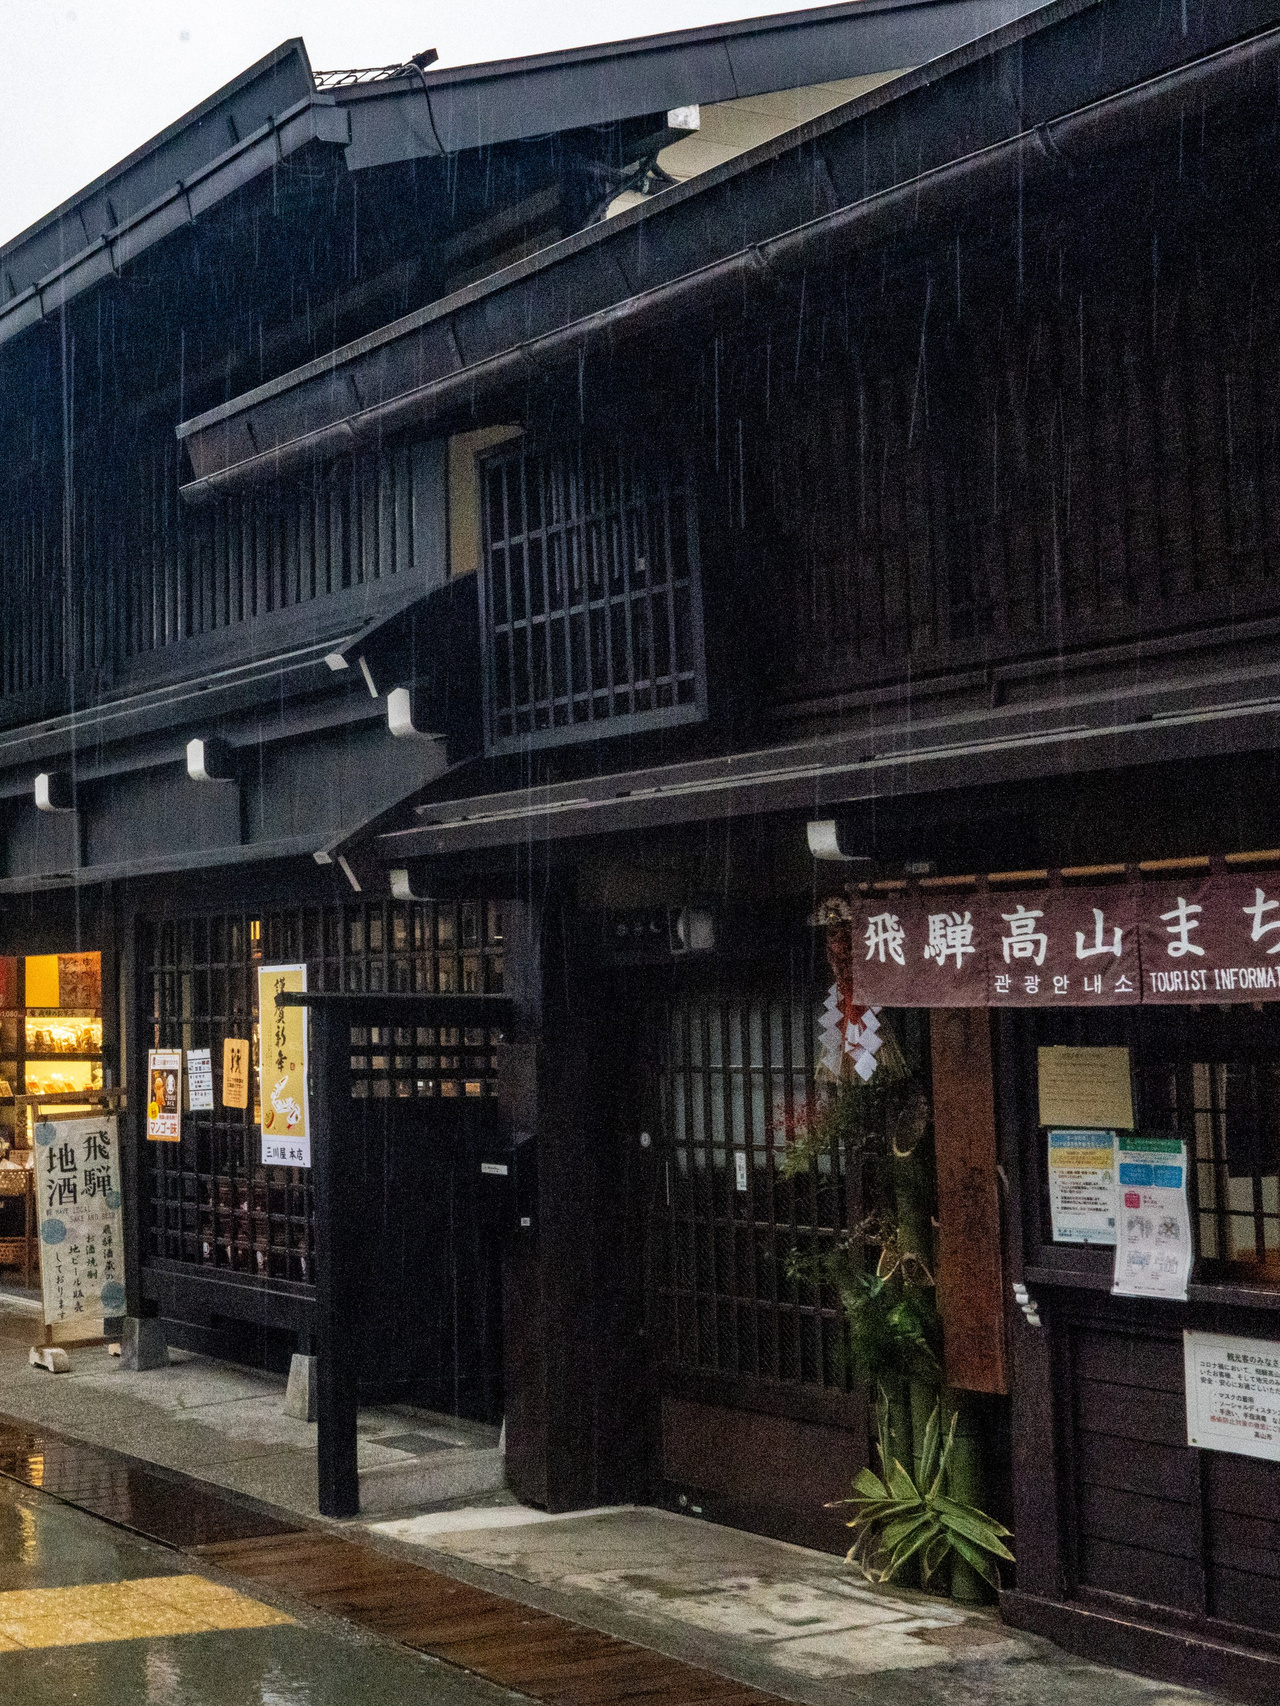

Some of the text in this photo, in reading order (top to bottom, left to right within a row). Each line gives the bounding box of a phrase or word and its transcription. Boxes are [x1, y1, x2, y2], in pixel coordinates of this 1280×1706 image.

[863, 887, 1280, 970] 飛騨高山まち
[994, 974, 1134, 995] 관광안내소
[1149, 969, 1208, 993] TOURIST
[150, 1121, 177, 1135] マンゴー味
[81, 1130, 113, 1198] 飛騨
[289, 1147, 304, 1161] 本店
[46, 1142, 78, 1207] 地酒
